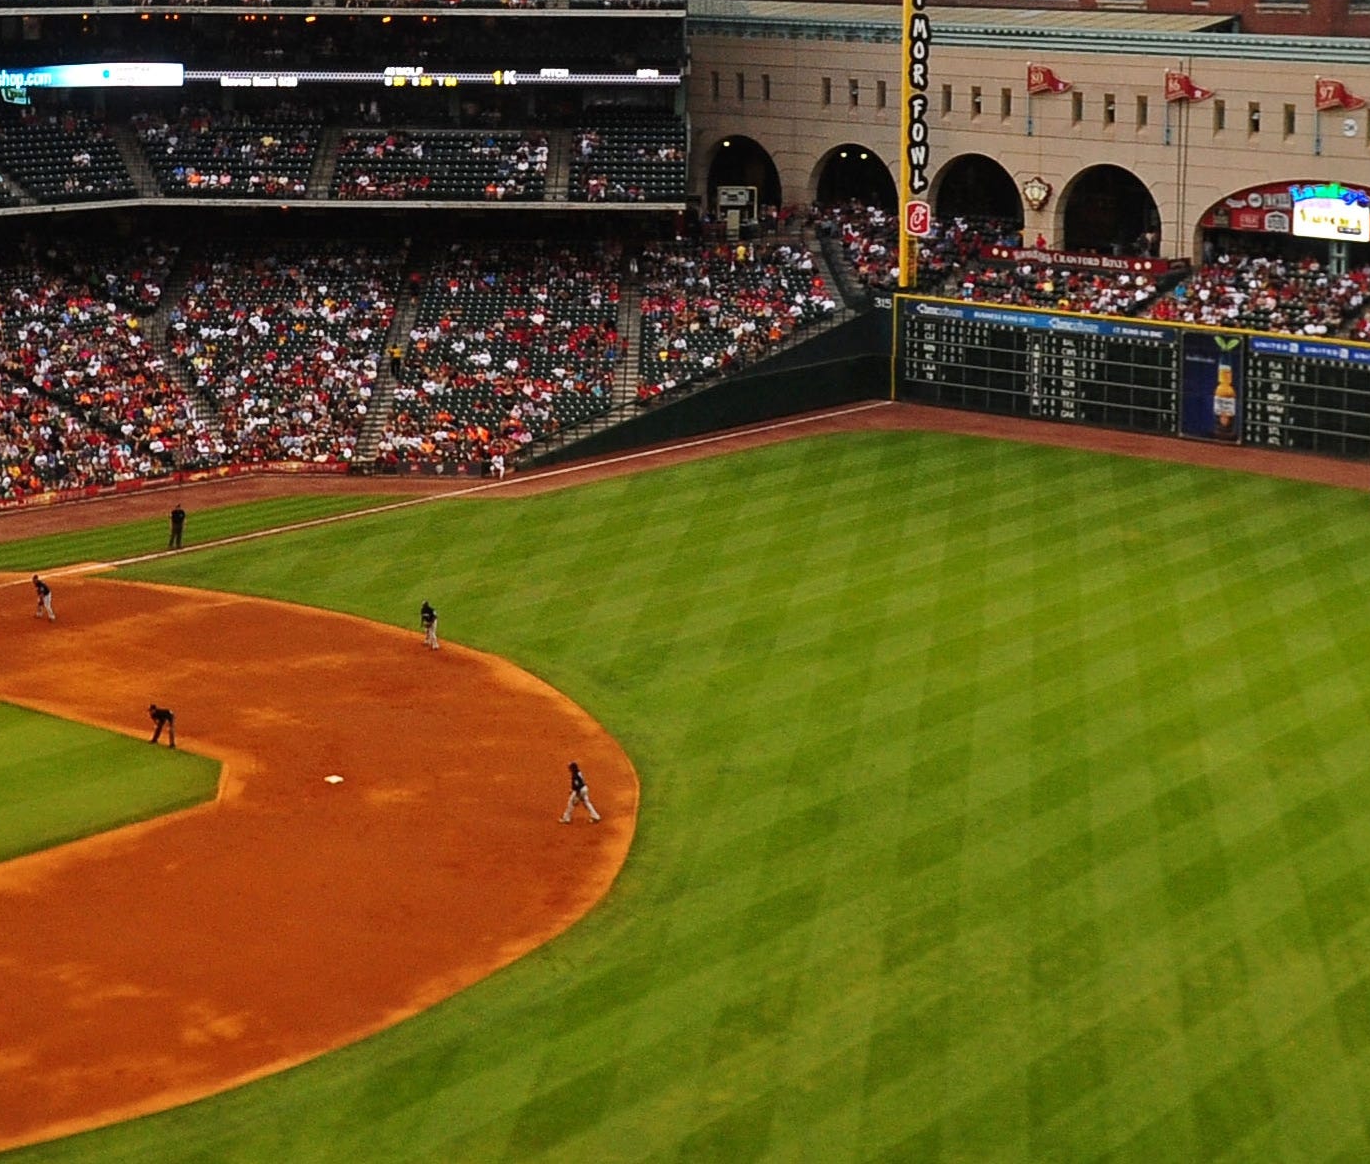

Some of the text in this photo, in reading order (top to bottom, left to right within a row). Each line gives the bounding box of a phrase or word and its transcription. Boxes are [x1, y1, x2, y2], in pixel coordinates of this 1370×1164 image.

[913, 18, 928, 85] MOR
[493, 70, 517, 85] 1 K
[1319, 86, 1334, 99] 97
[911, 99, 926, 190] FOWL
[874, 297, 892, 309] 315
